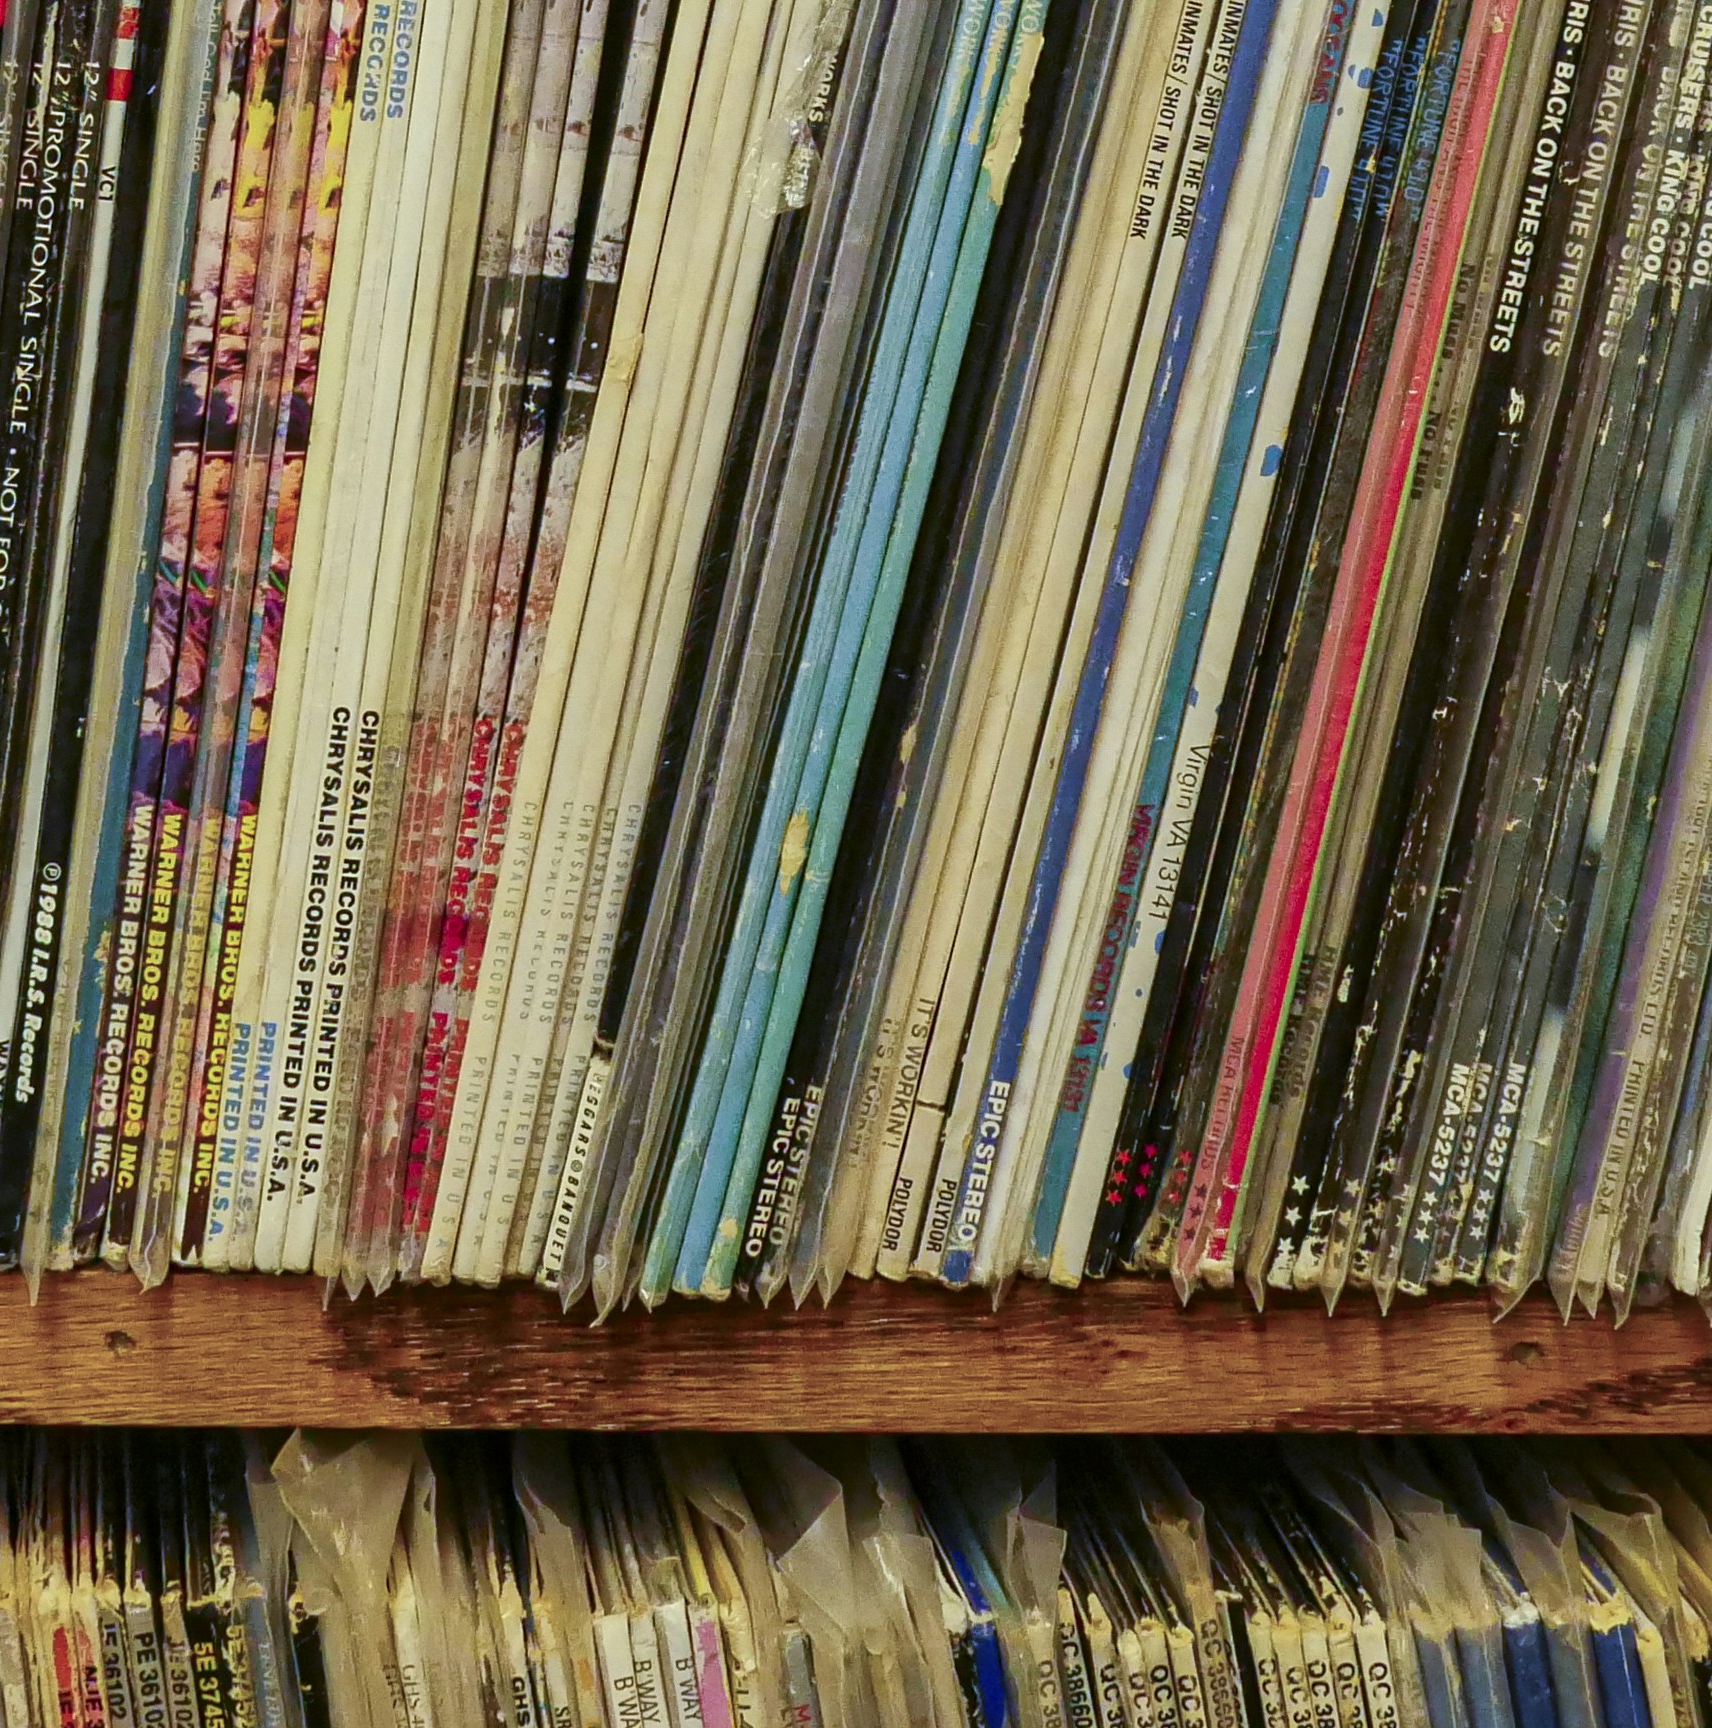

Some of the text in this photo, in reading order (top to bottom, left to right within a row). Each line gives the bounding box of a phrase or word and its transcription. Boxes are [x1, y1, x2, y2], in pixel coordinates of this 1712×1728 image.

[1538, 59, 1576, 134] BACK
[67, 111, 93, 209] SINGLE
[1529, 137, 1558, 177] ON
[22, 109, 66, 324] PROMOTIONAL
[1515, 181, 1548, 235] THE
[1488, 237, 1536, 355] STREETS
[8, 335, 37, 435] SINGLE
[342, 709, 380, 851] CHRYSALIS
[326, 857, 360, 977] RECORDS
[25, 948, 50, 1009] I.R.S.
[116, 813, 181, 1195] WARNER BROS. RECORDS INC.
[13, 1013, 42, 1103] Records
[310, 983, 343, 1092] PRINTED
[306, 1099, 328, 1123] IN
[743, 1094, 800, 1259] EPIC STEREO
[925, 1178, 958, 1253] POLYDOR
[194, 1641, 216, 1672] 5E
[510, 1676, 531, 1727] GHS
[1366, 1661, 1392, 1700] QC
